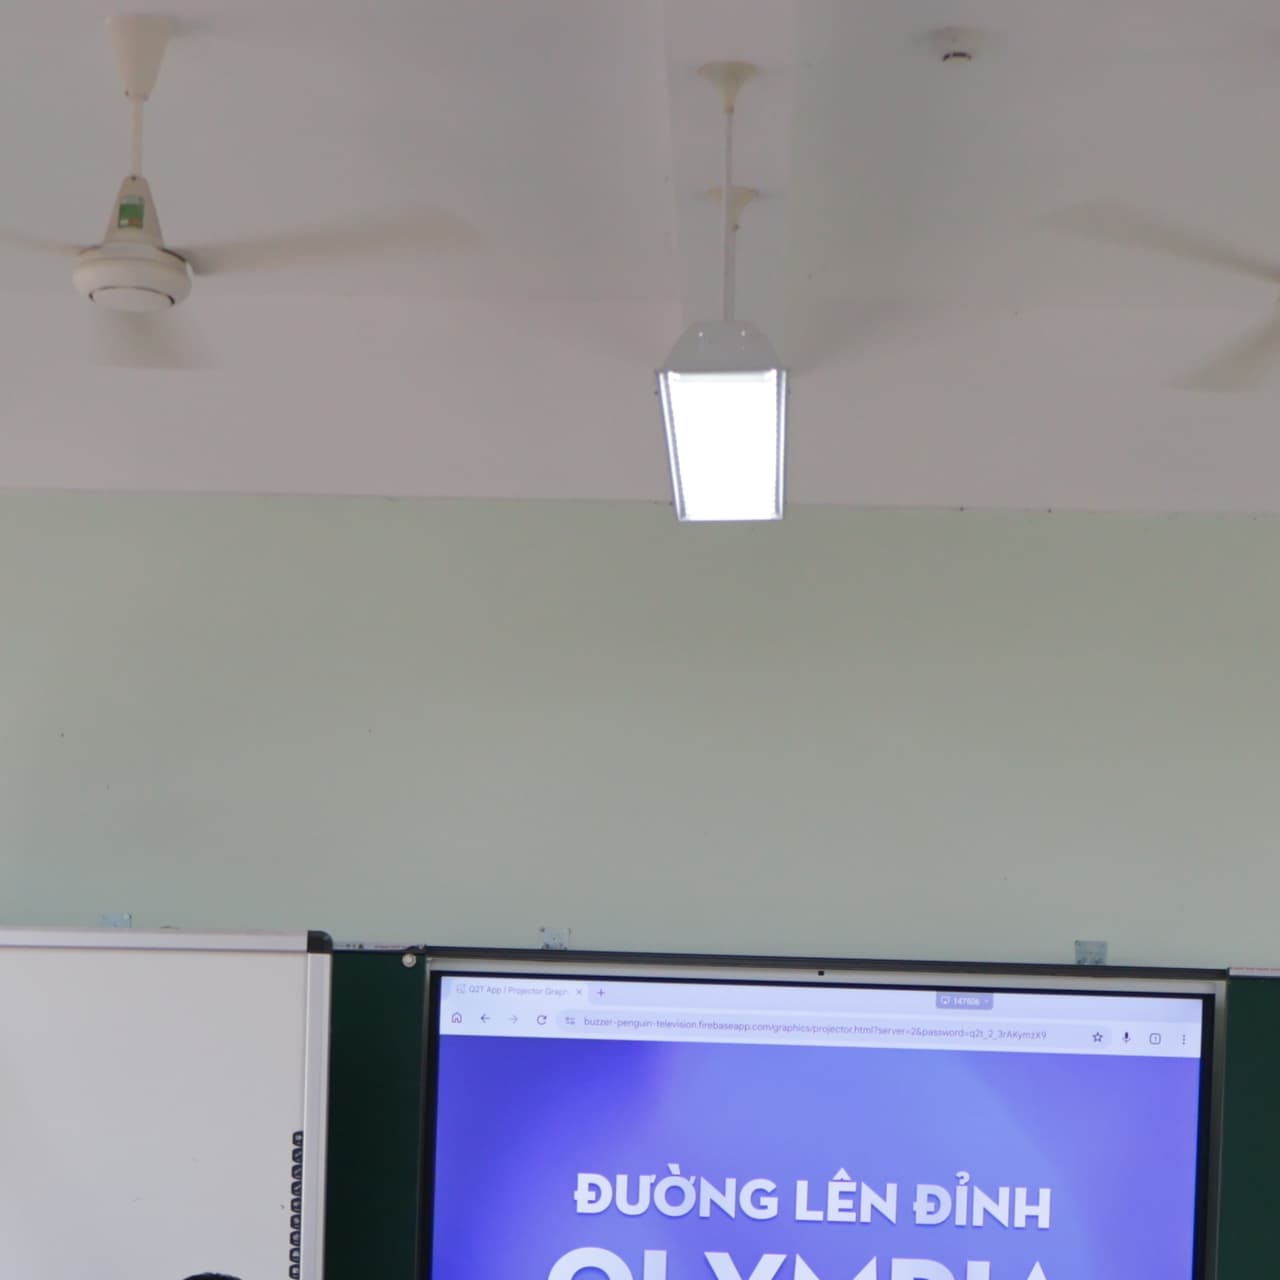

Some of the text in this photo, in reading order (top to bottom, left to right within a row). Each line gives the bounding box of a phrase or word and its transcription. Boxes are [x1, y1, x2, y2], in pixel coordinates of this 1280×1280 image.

[573, 1162, 1052, 1230] ĐƯỜNG LÊN ĐỈNH
